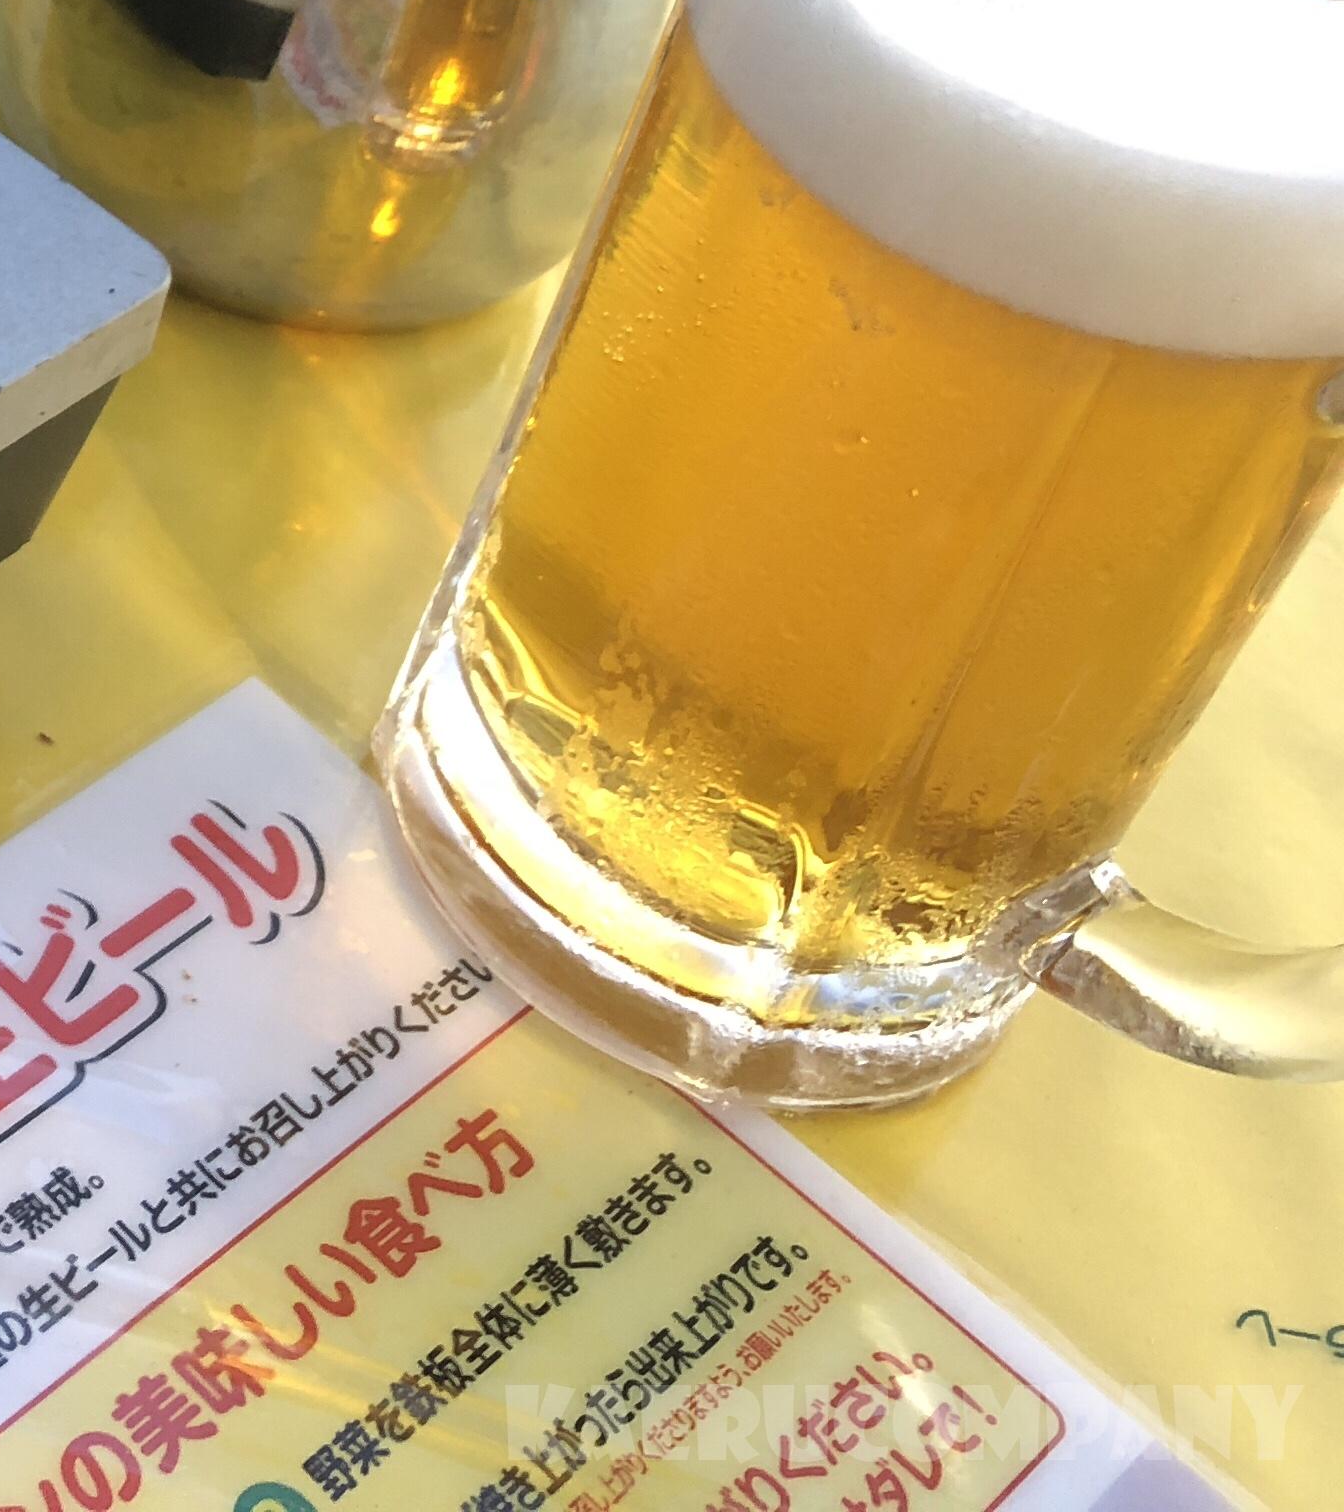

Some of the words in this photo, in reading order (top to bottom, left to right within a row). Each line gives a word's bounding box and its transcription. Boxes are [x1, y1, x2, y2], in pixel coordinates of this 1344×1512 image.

[302, 1151, 713, 1502] 野菜を鉄板全体に薄く敷きます。
